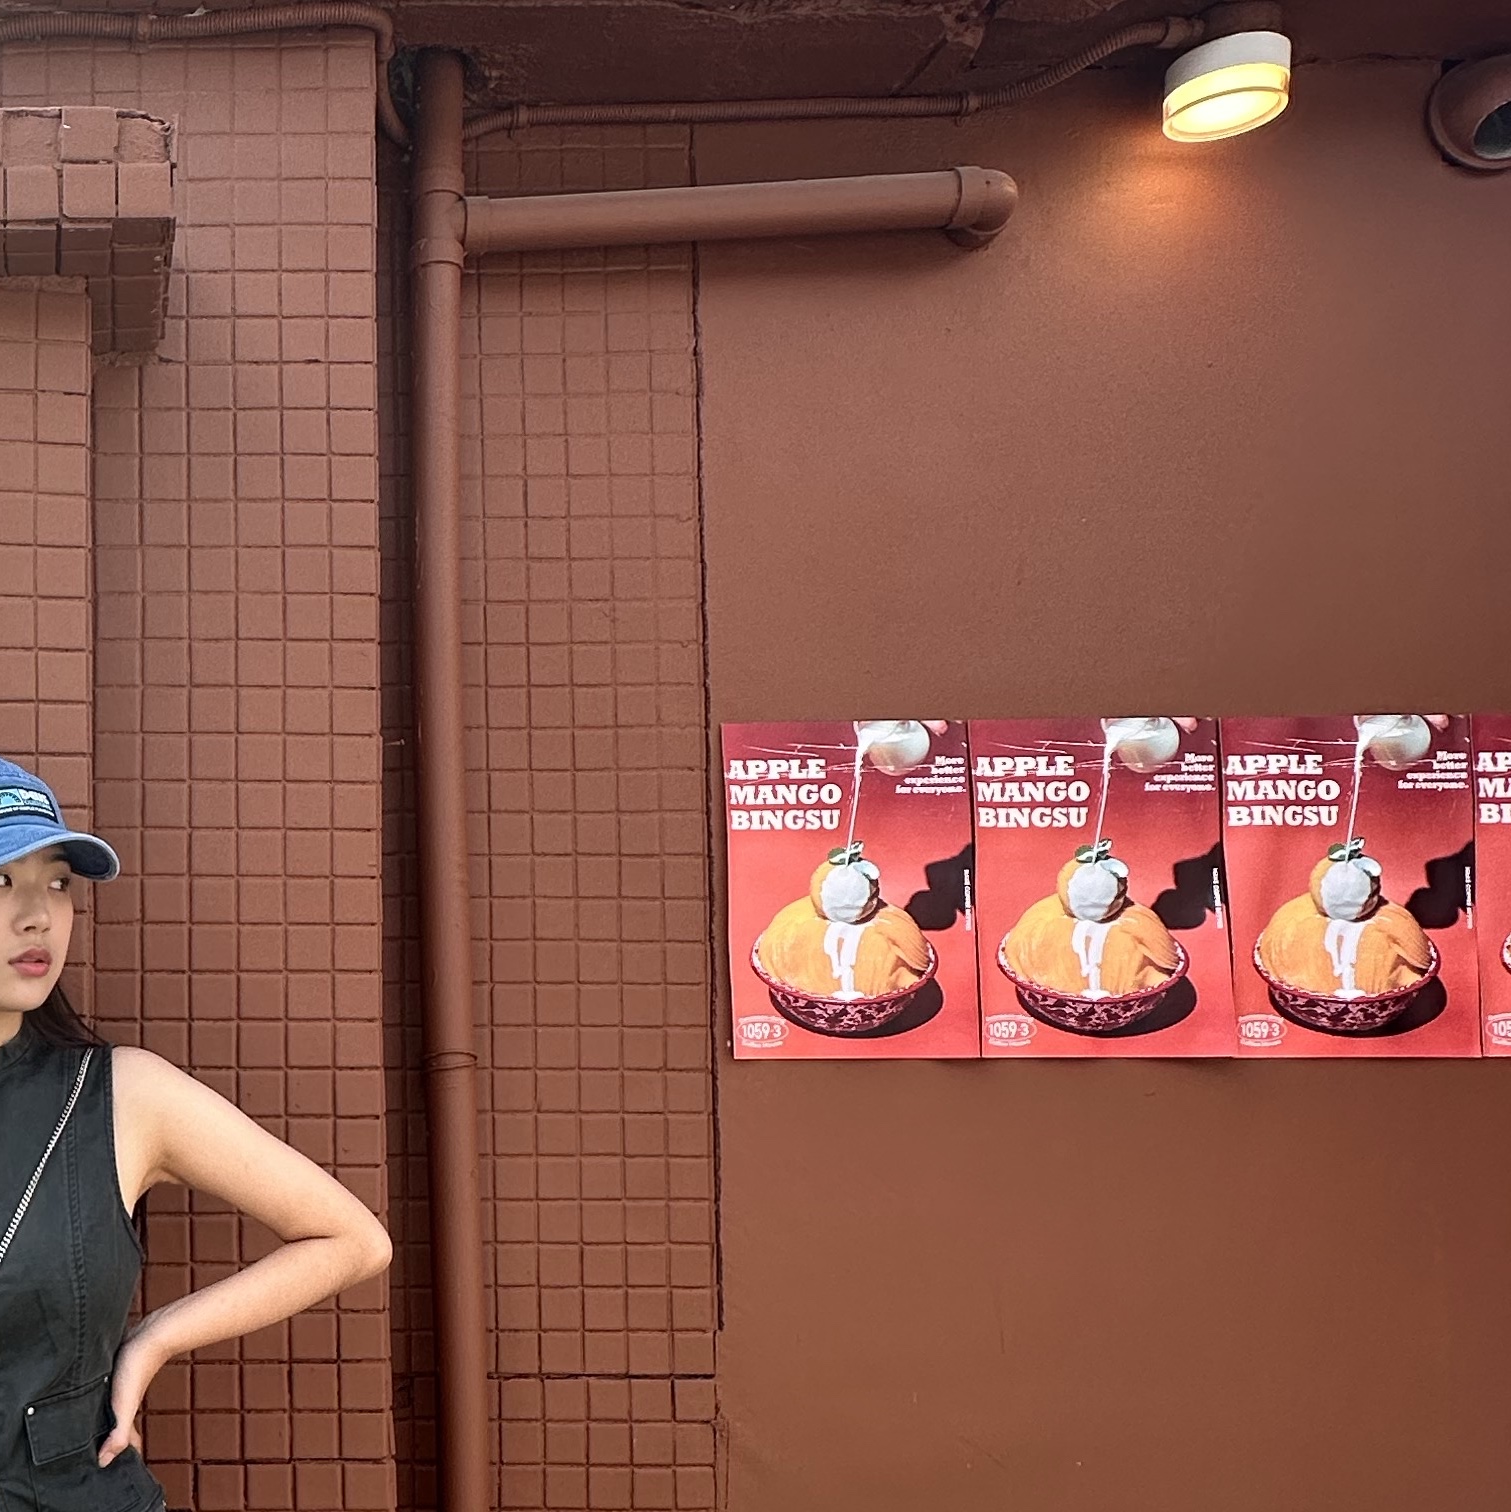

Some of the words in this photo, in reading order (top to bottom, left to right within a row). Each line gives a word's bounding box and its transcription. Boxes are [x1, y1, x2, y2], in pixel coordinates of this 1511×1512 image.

[935, 756, 965, 766] More
[975, 756, 1075, 777] APPLE
[1184, 753, 1215, 764] More
[1226, 754, 1323, 775] APPLE
[1436, 751, 1467, 761] More
[728, 759, 827, 780] APPLE
[729, 783, 843, 805] MANGO
[976, 781, 1091, 802] MANGO
[1227, 779, 1341, 801] MANGO
[730, 809, 841, 831] BINGSU
[978, 807, 1089, 828] BINGSU
[1228, 806, 1339, 827] BINGSU
